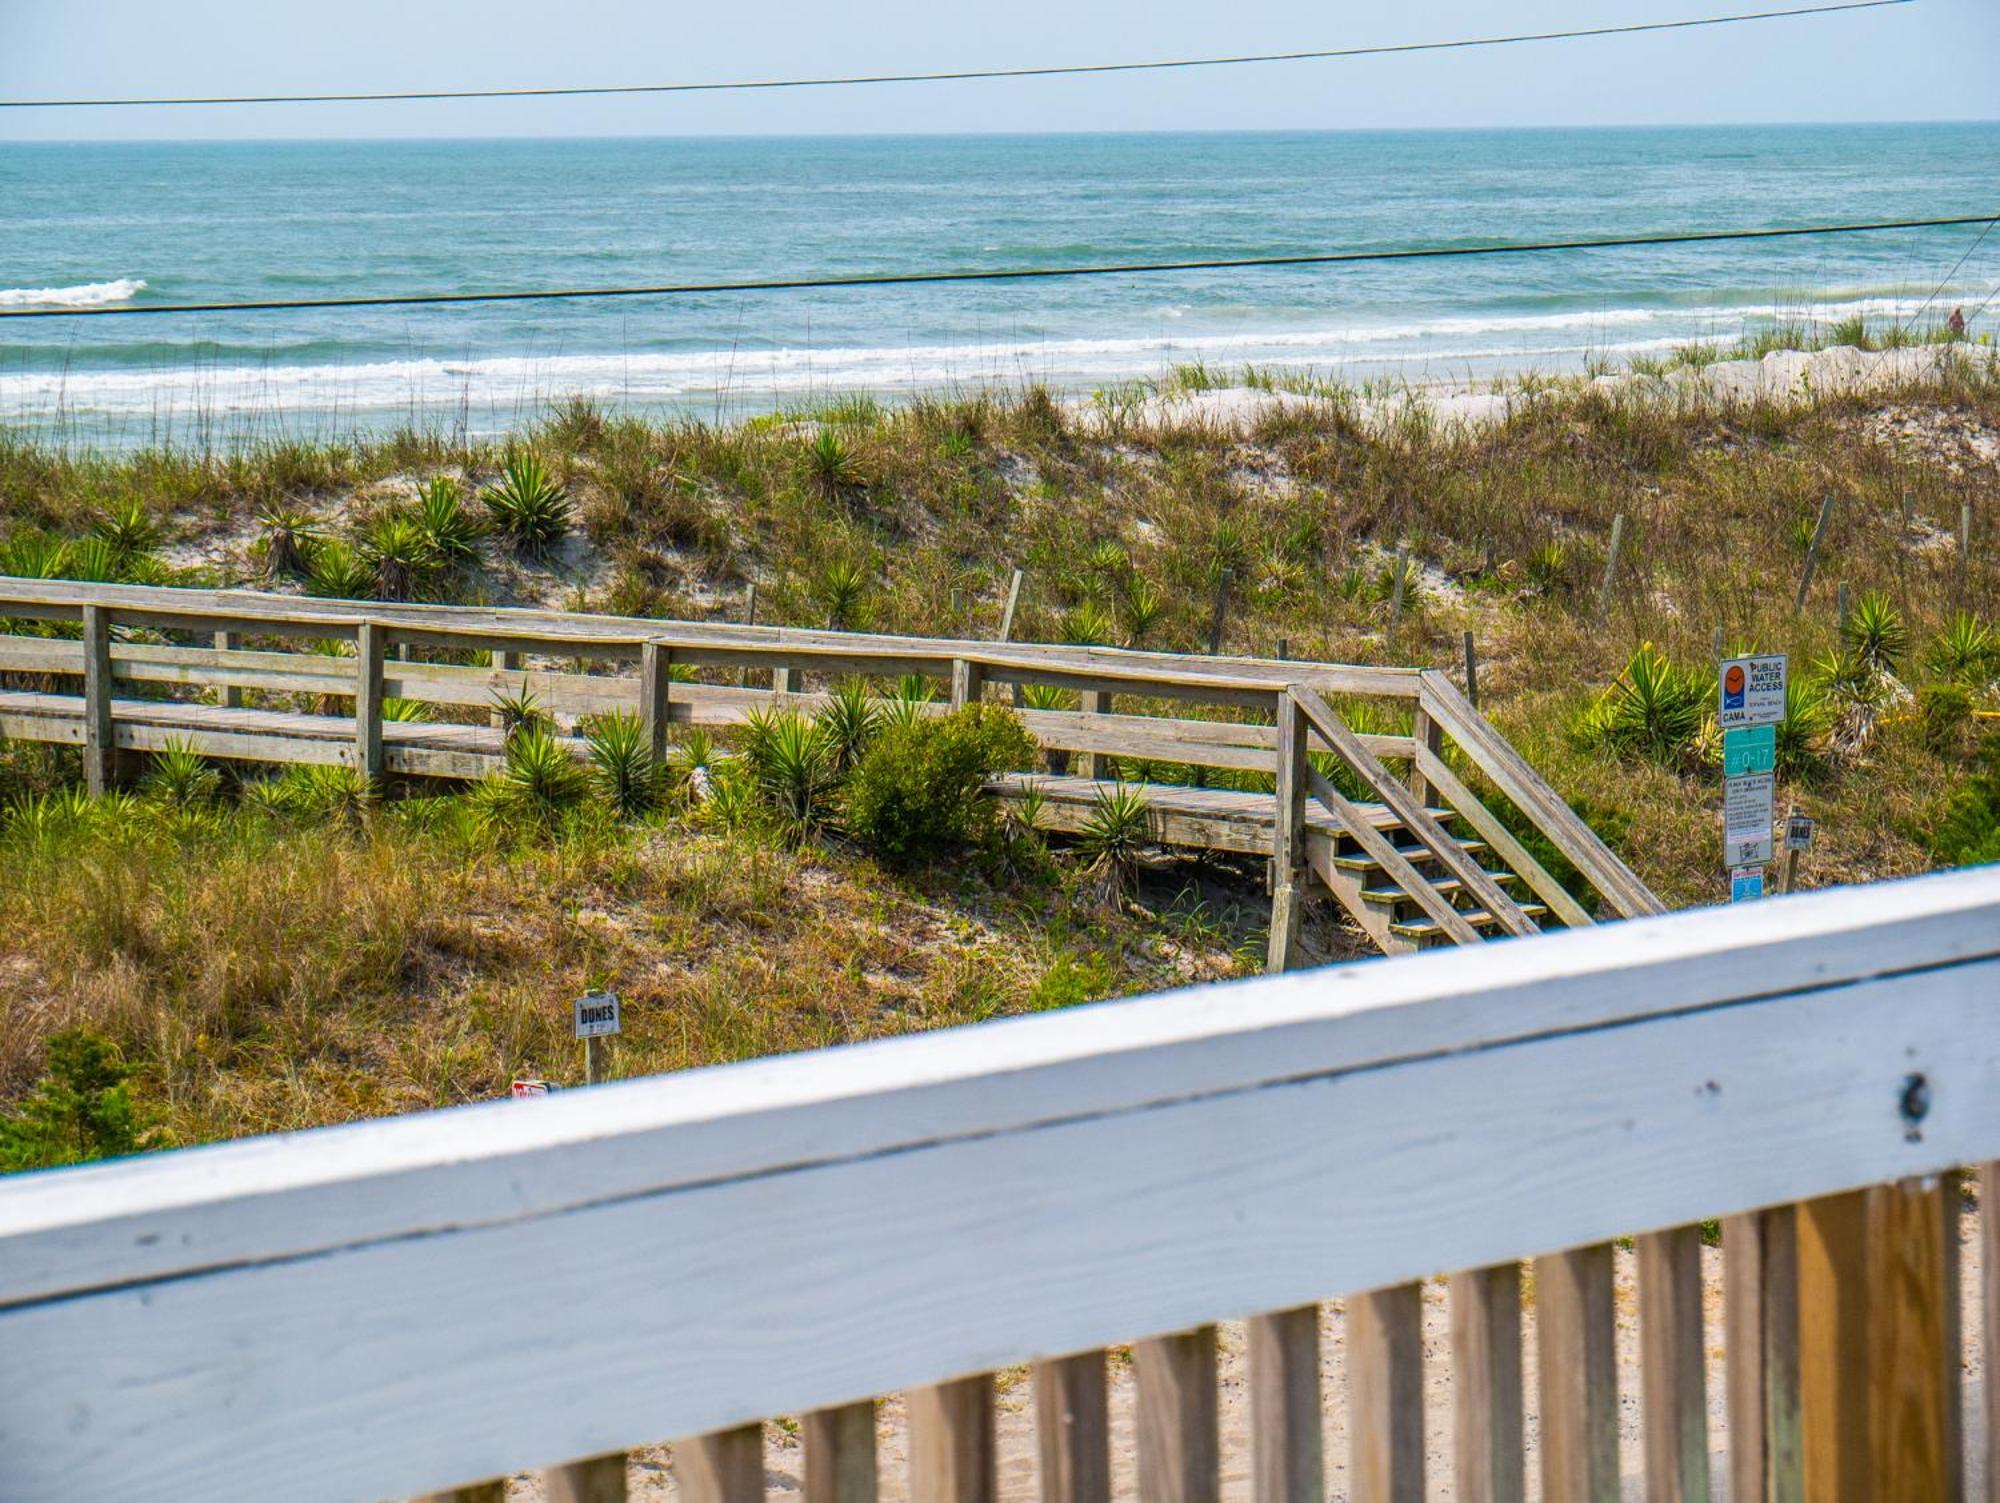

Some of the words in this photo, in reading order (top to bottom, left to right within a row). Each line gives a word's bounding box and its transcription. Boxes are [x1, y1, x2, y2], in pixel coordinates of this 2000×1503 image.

[1751, 662, 1782, 672] PUBLIC
[1751, 672, 1781, 682] WATER
[1749, 682, 1783, 692] ACCESS
[1723, 711, 1745, 722] CAMA
[581, 1005, 614, 1024] DUNES
